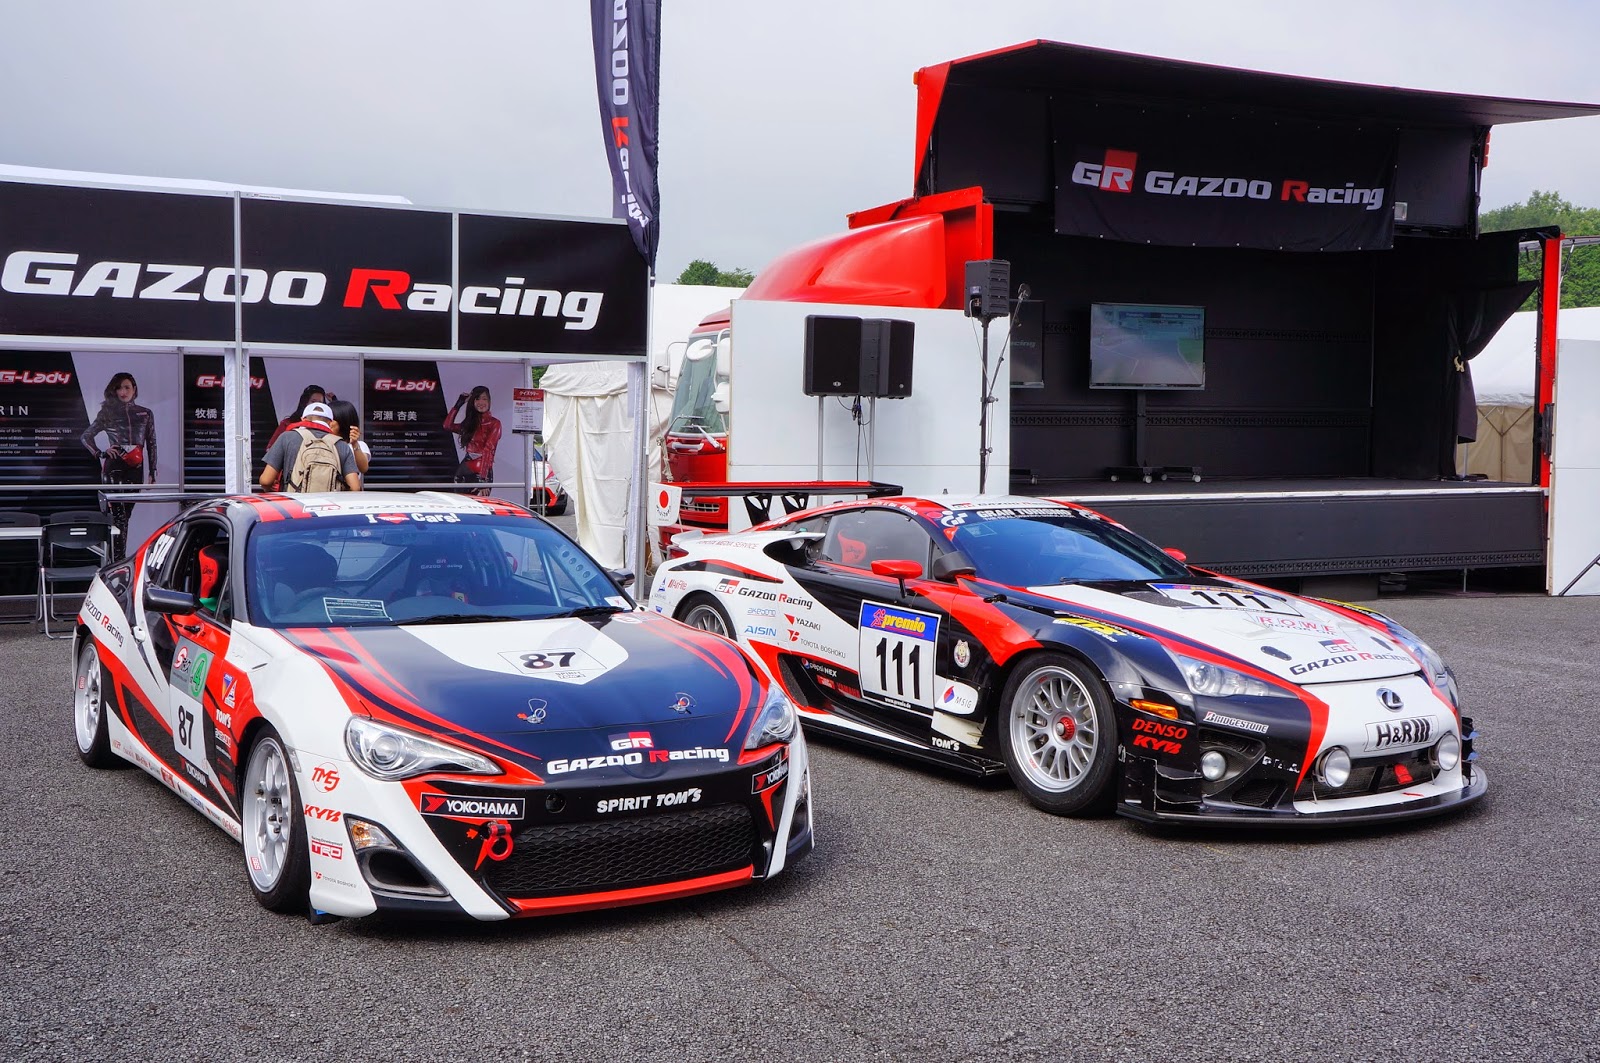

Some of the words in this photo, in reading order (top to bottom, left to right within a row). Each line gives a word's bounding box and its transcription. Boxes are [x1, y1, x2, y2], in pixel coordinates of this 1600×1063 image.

[1072, 161, 1134, 192] GR
[1144, 170, 1272, 200] GAZOO
[1281, 180, 1385, 211] Racing
[0, 250, 327, 308] GAZOO
[343, 267, 604, 331] Racing
[374, 379, 437, 391] G-Lady
[976, 508, 1016, 518] GRAN
[738, 587, 777, 601] GAZOO
[779, 593, 813, 610] Racing
[1190, 590, 1273, 609] 111
[101, 615, 124, 648] Racing
[744, 625, 777, 637] AISIN
[795, 617, 821, 631] YAZAKI
[882, 614, 926, 633] premio
[800, 638, 820, 650] TOYOTA
[820, 644, 846, 659] BOSHOKU
[519, 651, 576, 669] 87
[876, 637, 921, 701] 111
[1289, 654, 1357, 676] GAZOO
[1357, 652, 1415, 665] Racing
[824, 667, 838, 678] NEX
[955, 696, 972, 709] MSIG
[178, 705, 194, 750] 87
[1132, 718, 1188, 740] DENSO
[1203, 711, 1269, 734] BRIDGESTONE
[611, 737, 654, 752] GR
[931, 736, 960, 752] TOM'S
[1132, 734, 1182, 755] KYB
[546, 752, 643, 775] GAZOO
[648, 746, 730, 765] Racing
[656, 788, 702, 807] TOM'S
[303, 803, 342, 823] KYB
[446, 800, 518, 816] YOKOHAMA
[311, 840, 343, 861] TRD
